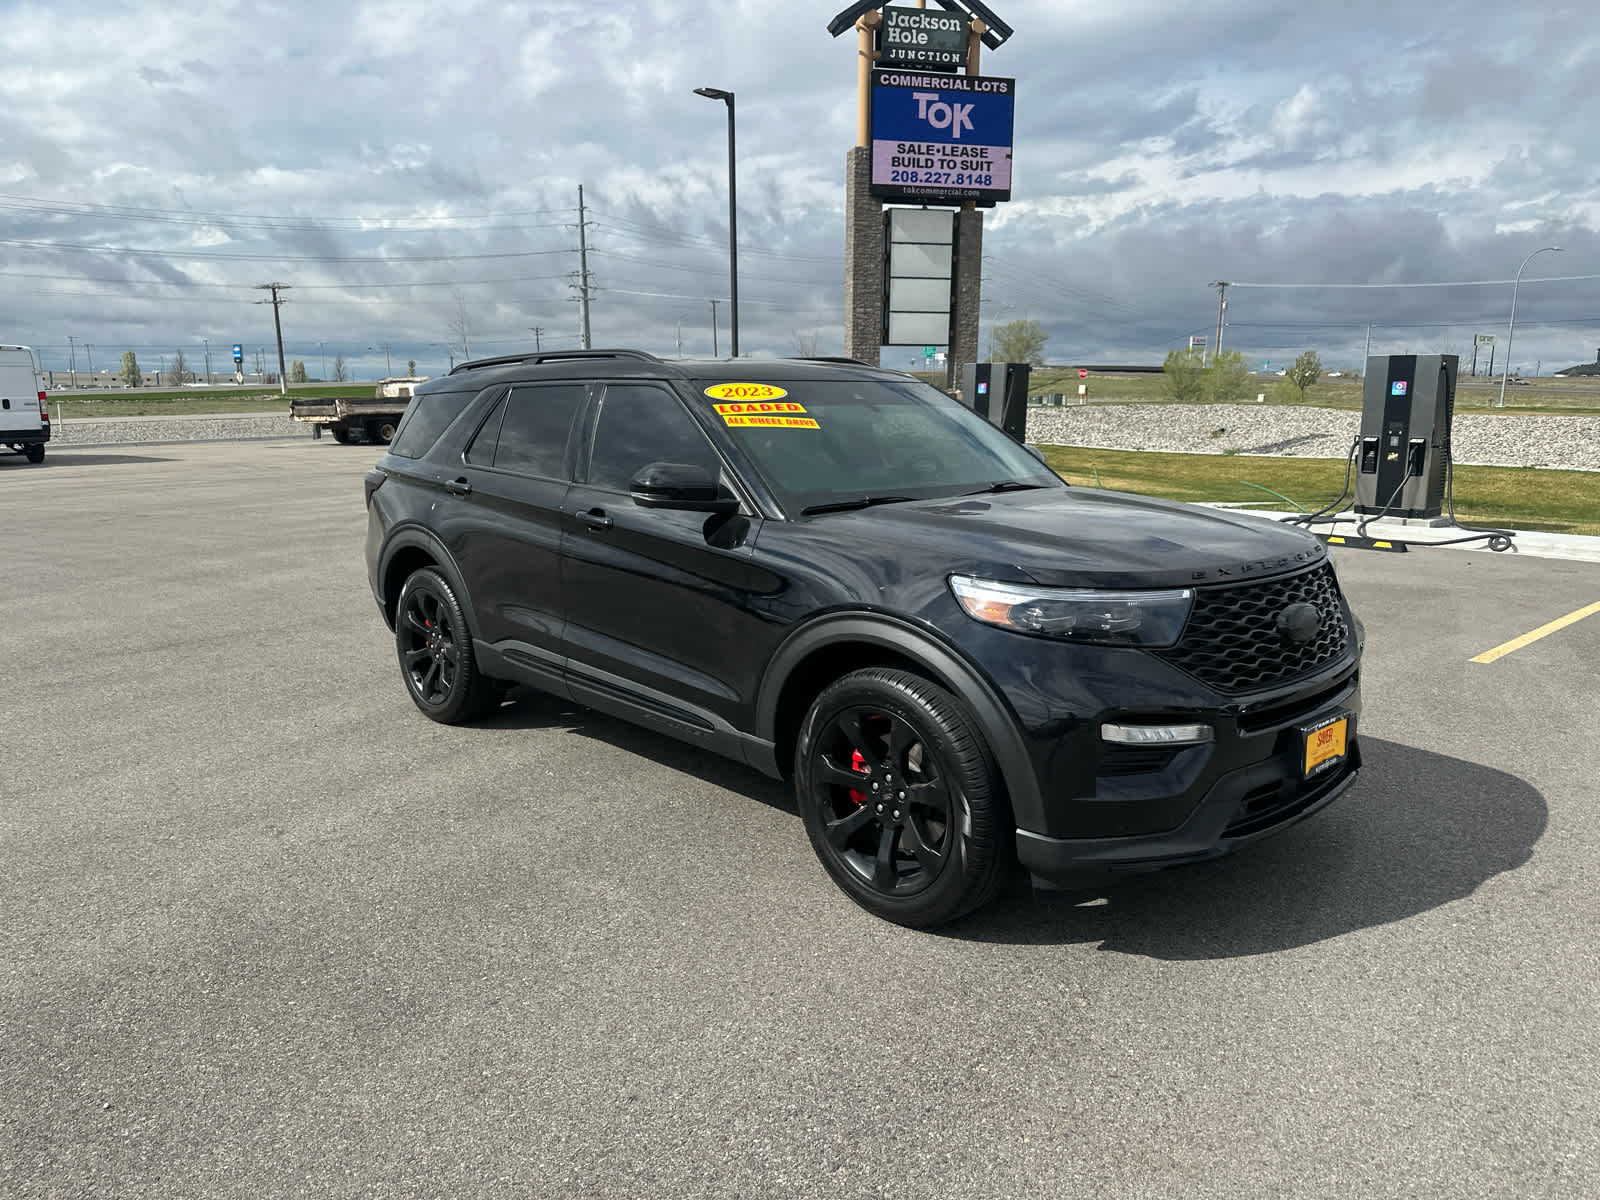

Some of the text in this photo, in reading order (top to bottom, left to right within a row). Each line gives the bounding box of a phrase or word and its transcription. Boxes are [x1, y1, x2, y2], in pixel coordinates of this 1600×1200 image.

[888, 11, 961, 32] Jackson
[887, 27, 929, 44] Hole
[889, 49, 961, 63] JUNCTION
[880, 74, 1008, 93] COMMERCIAL LOTS
[912, 92, 975, 138] TOK
[891, 156, 993, 172] BUILD TO SUIT
[890, 170, 993, 186] 208.227.8148
[903, 186, 980, 197] tokcommercial.com
[721, 386, 774, 398] 2023
[718, 403, 801, 413] LOADED
[727, 416, 817, 427] ALL WHEEL DRIVE
